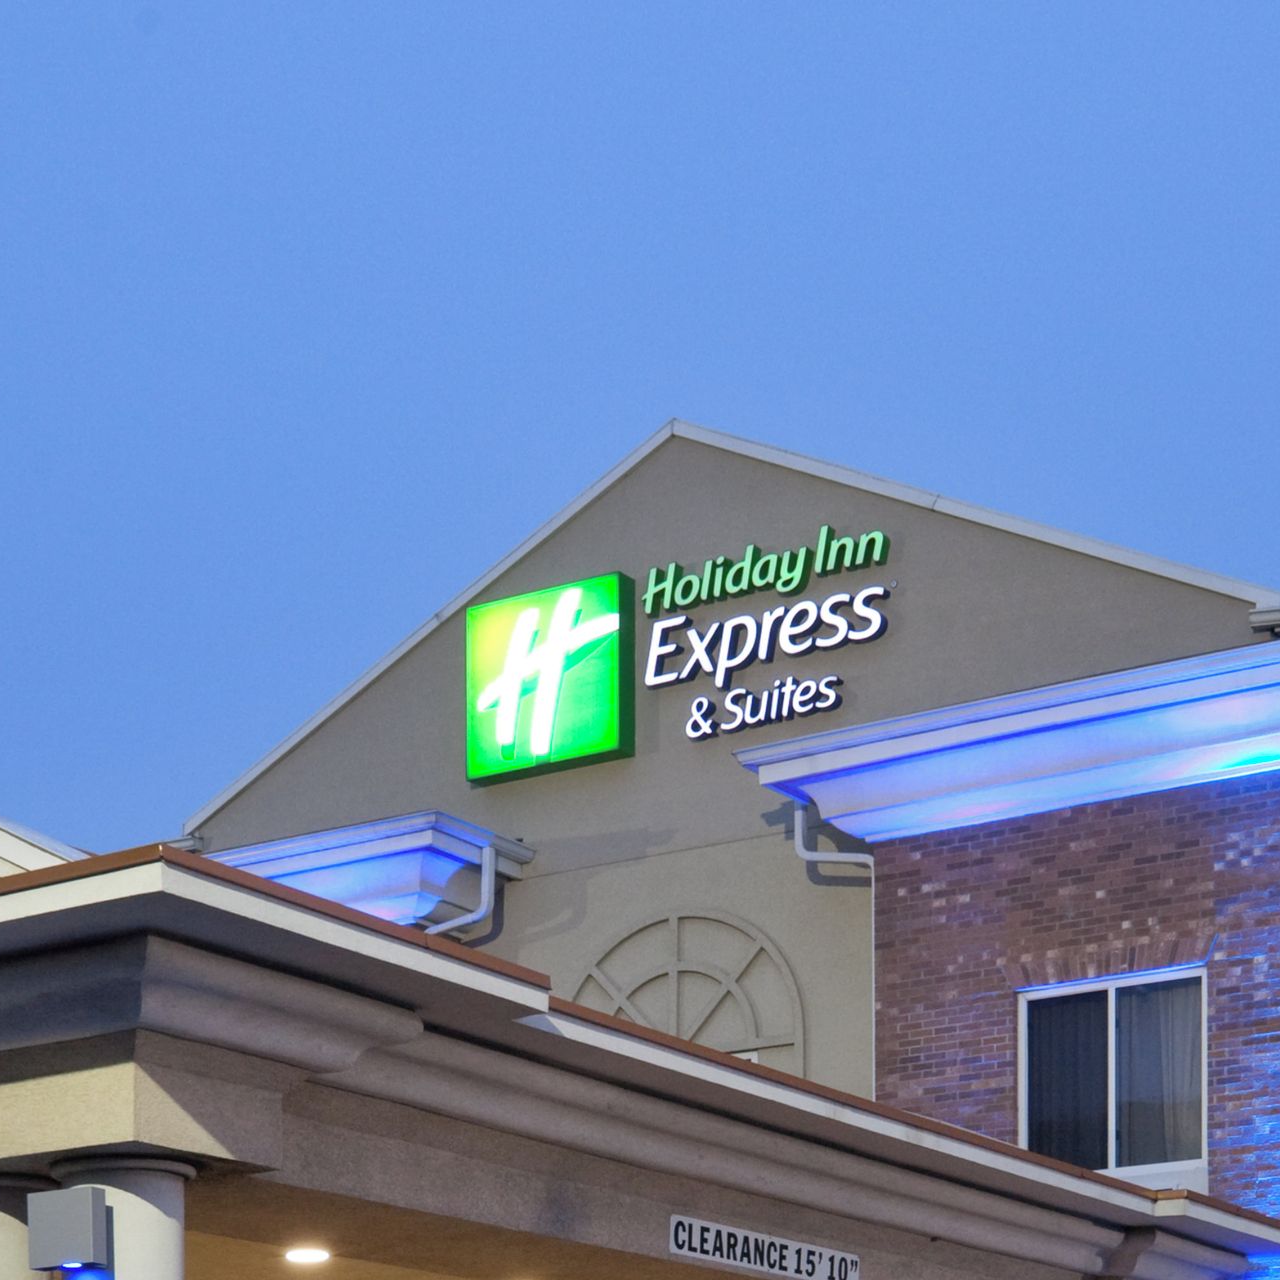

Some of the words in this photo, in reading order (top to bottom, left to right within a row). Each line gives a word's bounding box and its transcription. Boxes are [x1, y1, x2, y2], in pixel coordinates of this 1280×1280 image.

[642, 544, 808, 615] Holiday
[814, 524, 888, 574] Inn
[644, 585, 887, 689] Express
[685, 696, 715, 740] &
[721, 674, 841, 732] Suites
[673, 1219, 789, 1272] CLEARANCE
